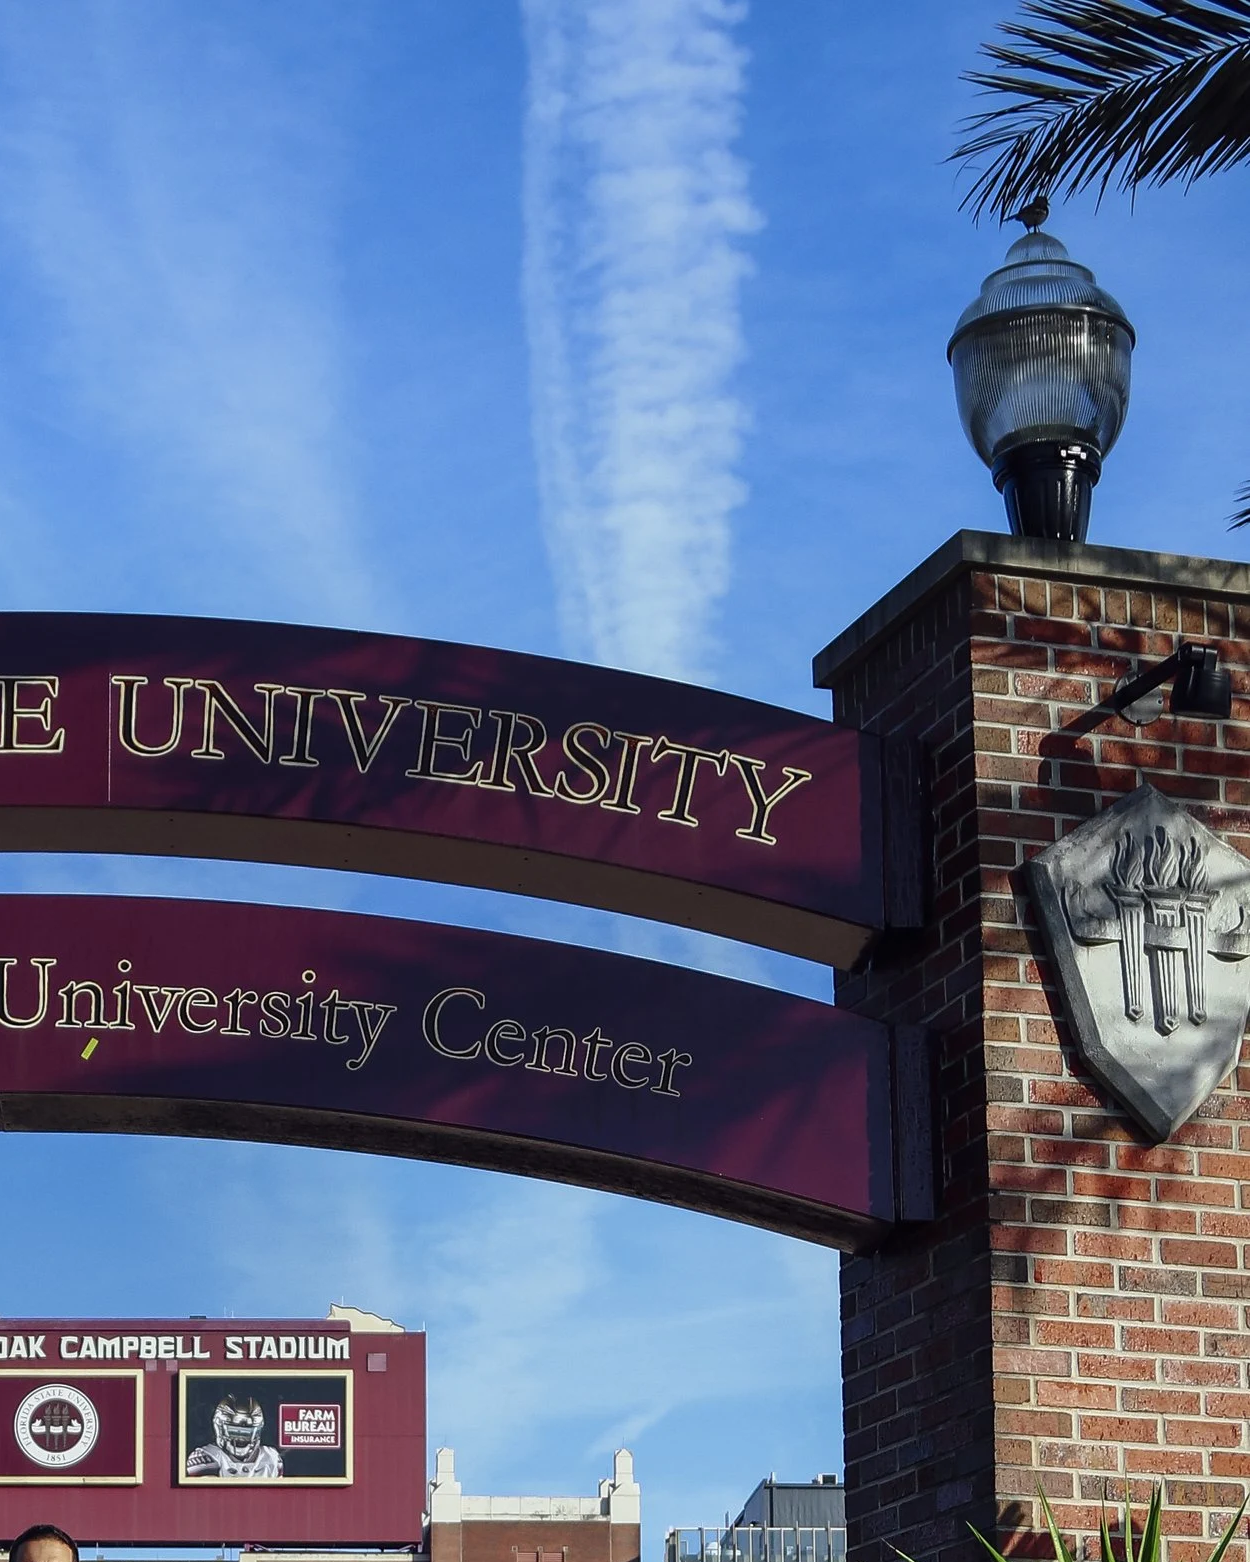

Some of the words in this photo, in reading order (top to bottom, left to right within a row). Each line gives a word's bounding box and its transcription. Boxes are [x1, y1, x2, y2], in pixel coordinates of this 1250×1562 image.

[110, 674, 813, 846] UNIVERSITY
[422, 986, 693, 1098] Center
[59, 1335, 211, 1360] CAMPBELL
[225, 1335, 351, 1360] STADIUM
[20, 1403, 34, 1446] FLORIDA
[34, 1389, 64, 1402] STATE
[68, 1392, 94, 1447] UNIVERSITY
[298, 1409, 336, 1421] FARM
[284, 1420, 336, 1433] BUREAU
[290, 1435, 336, 1444] INSURANCE
[46, 1454, 66, 1462] 1851
